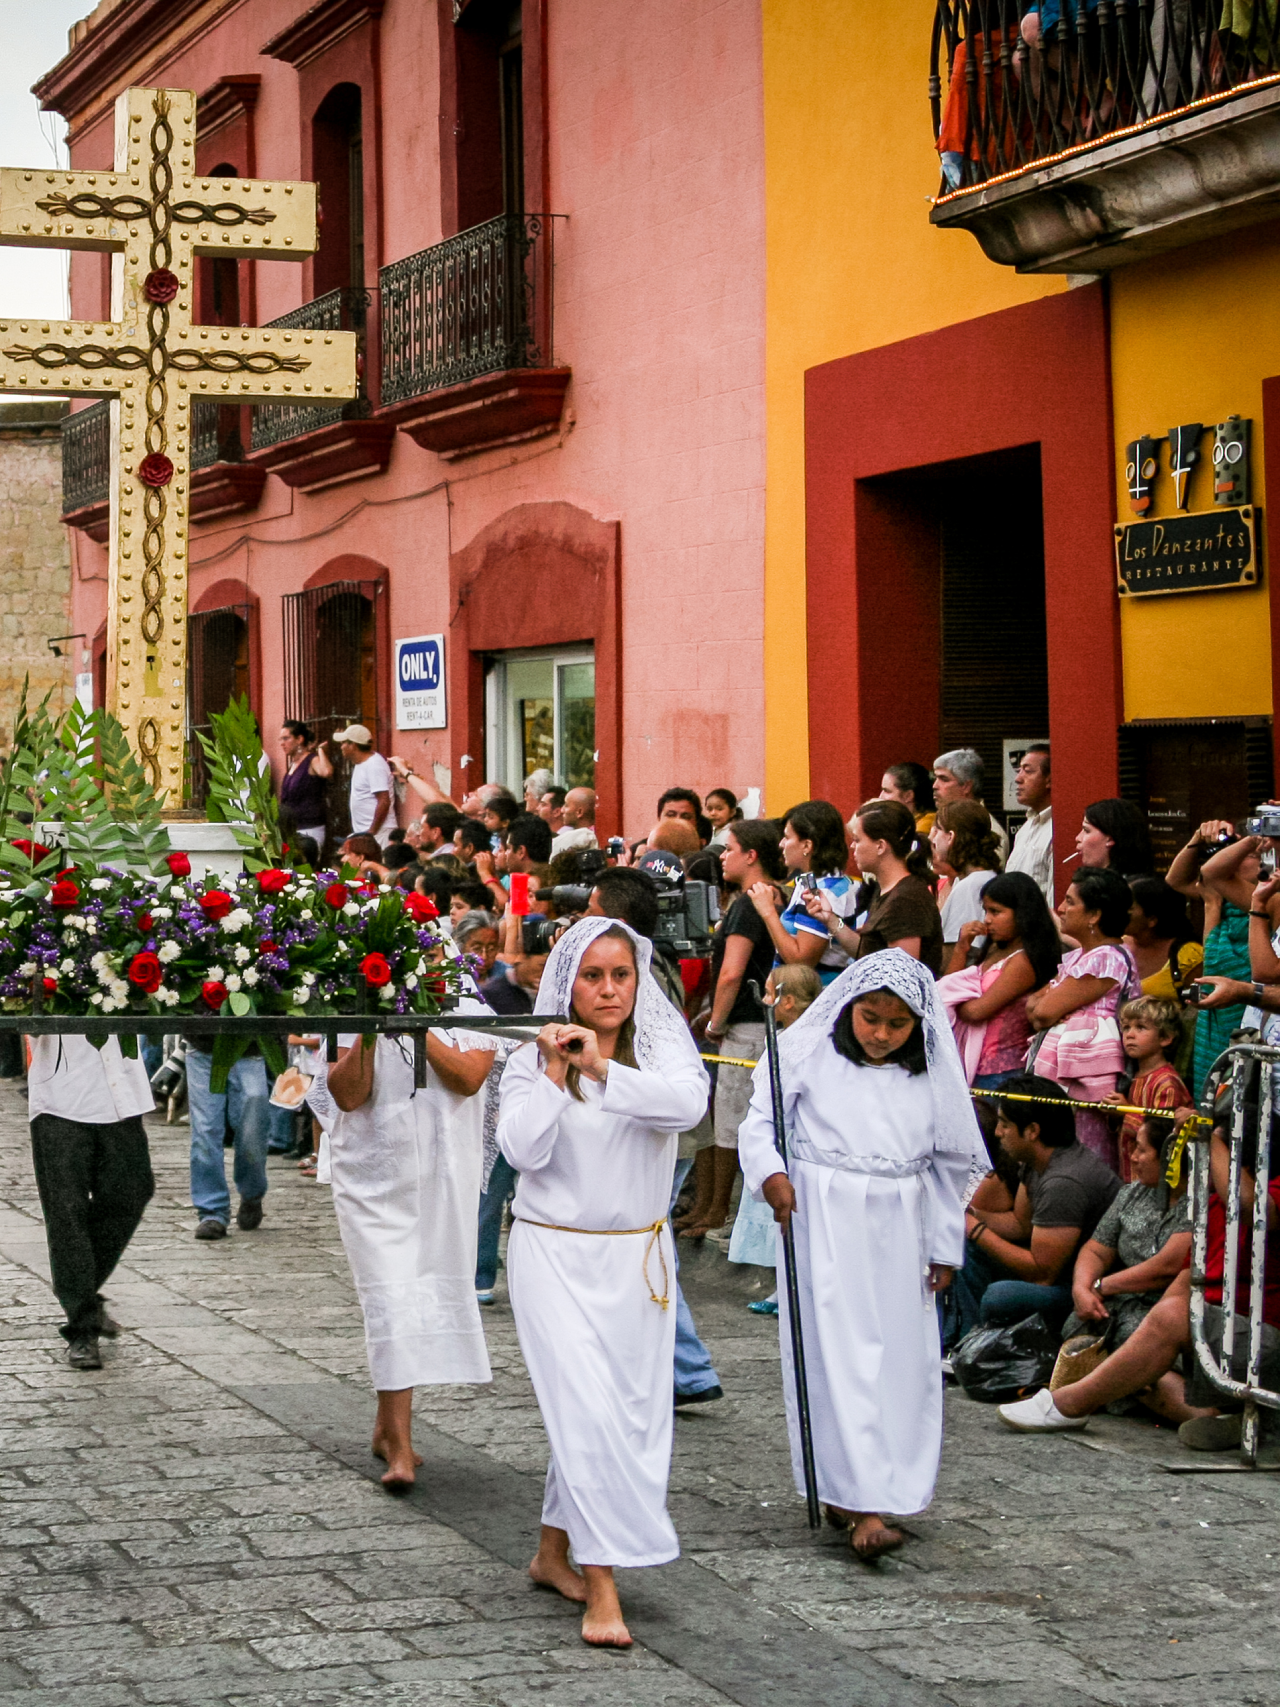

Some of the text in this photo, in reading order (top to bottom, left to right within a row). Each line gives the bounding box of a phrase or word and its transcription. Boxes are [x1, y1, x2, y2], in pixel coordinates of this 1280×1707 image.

[1125, 524, 1245, 562] Los Danzantes
[1125, 558, 1244, 580] RESTAURANTE
